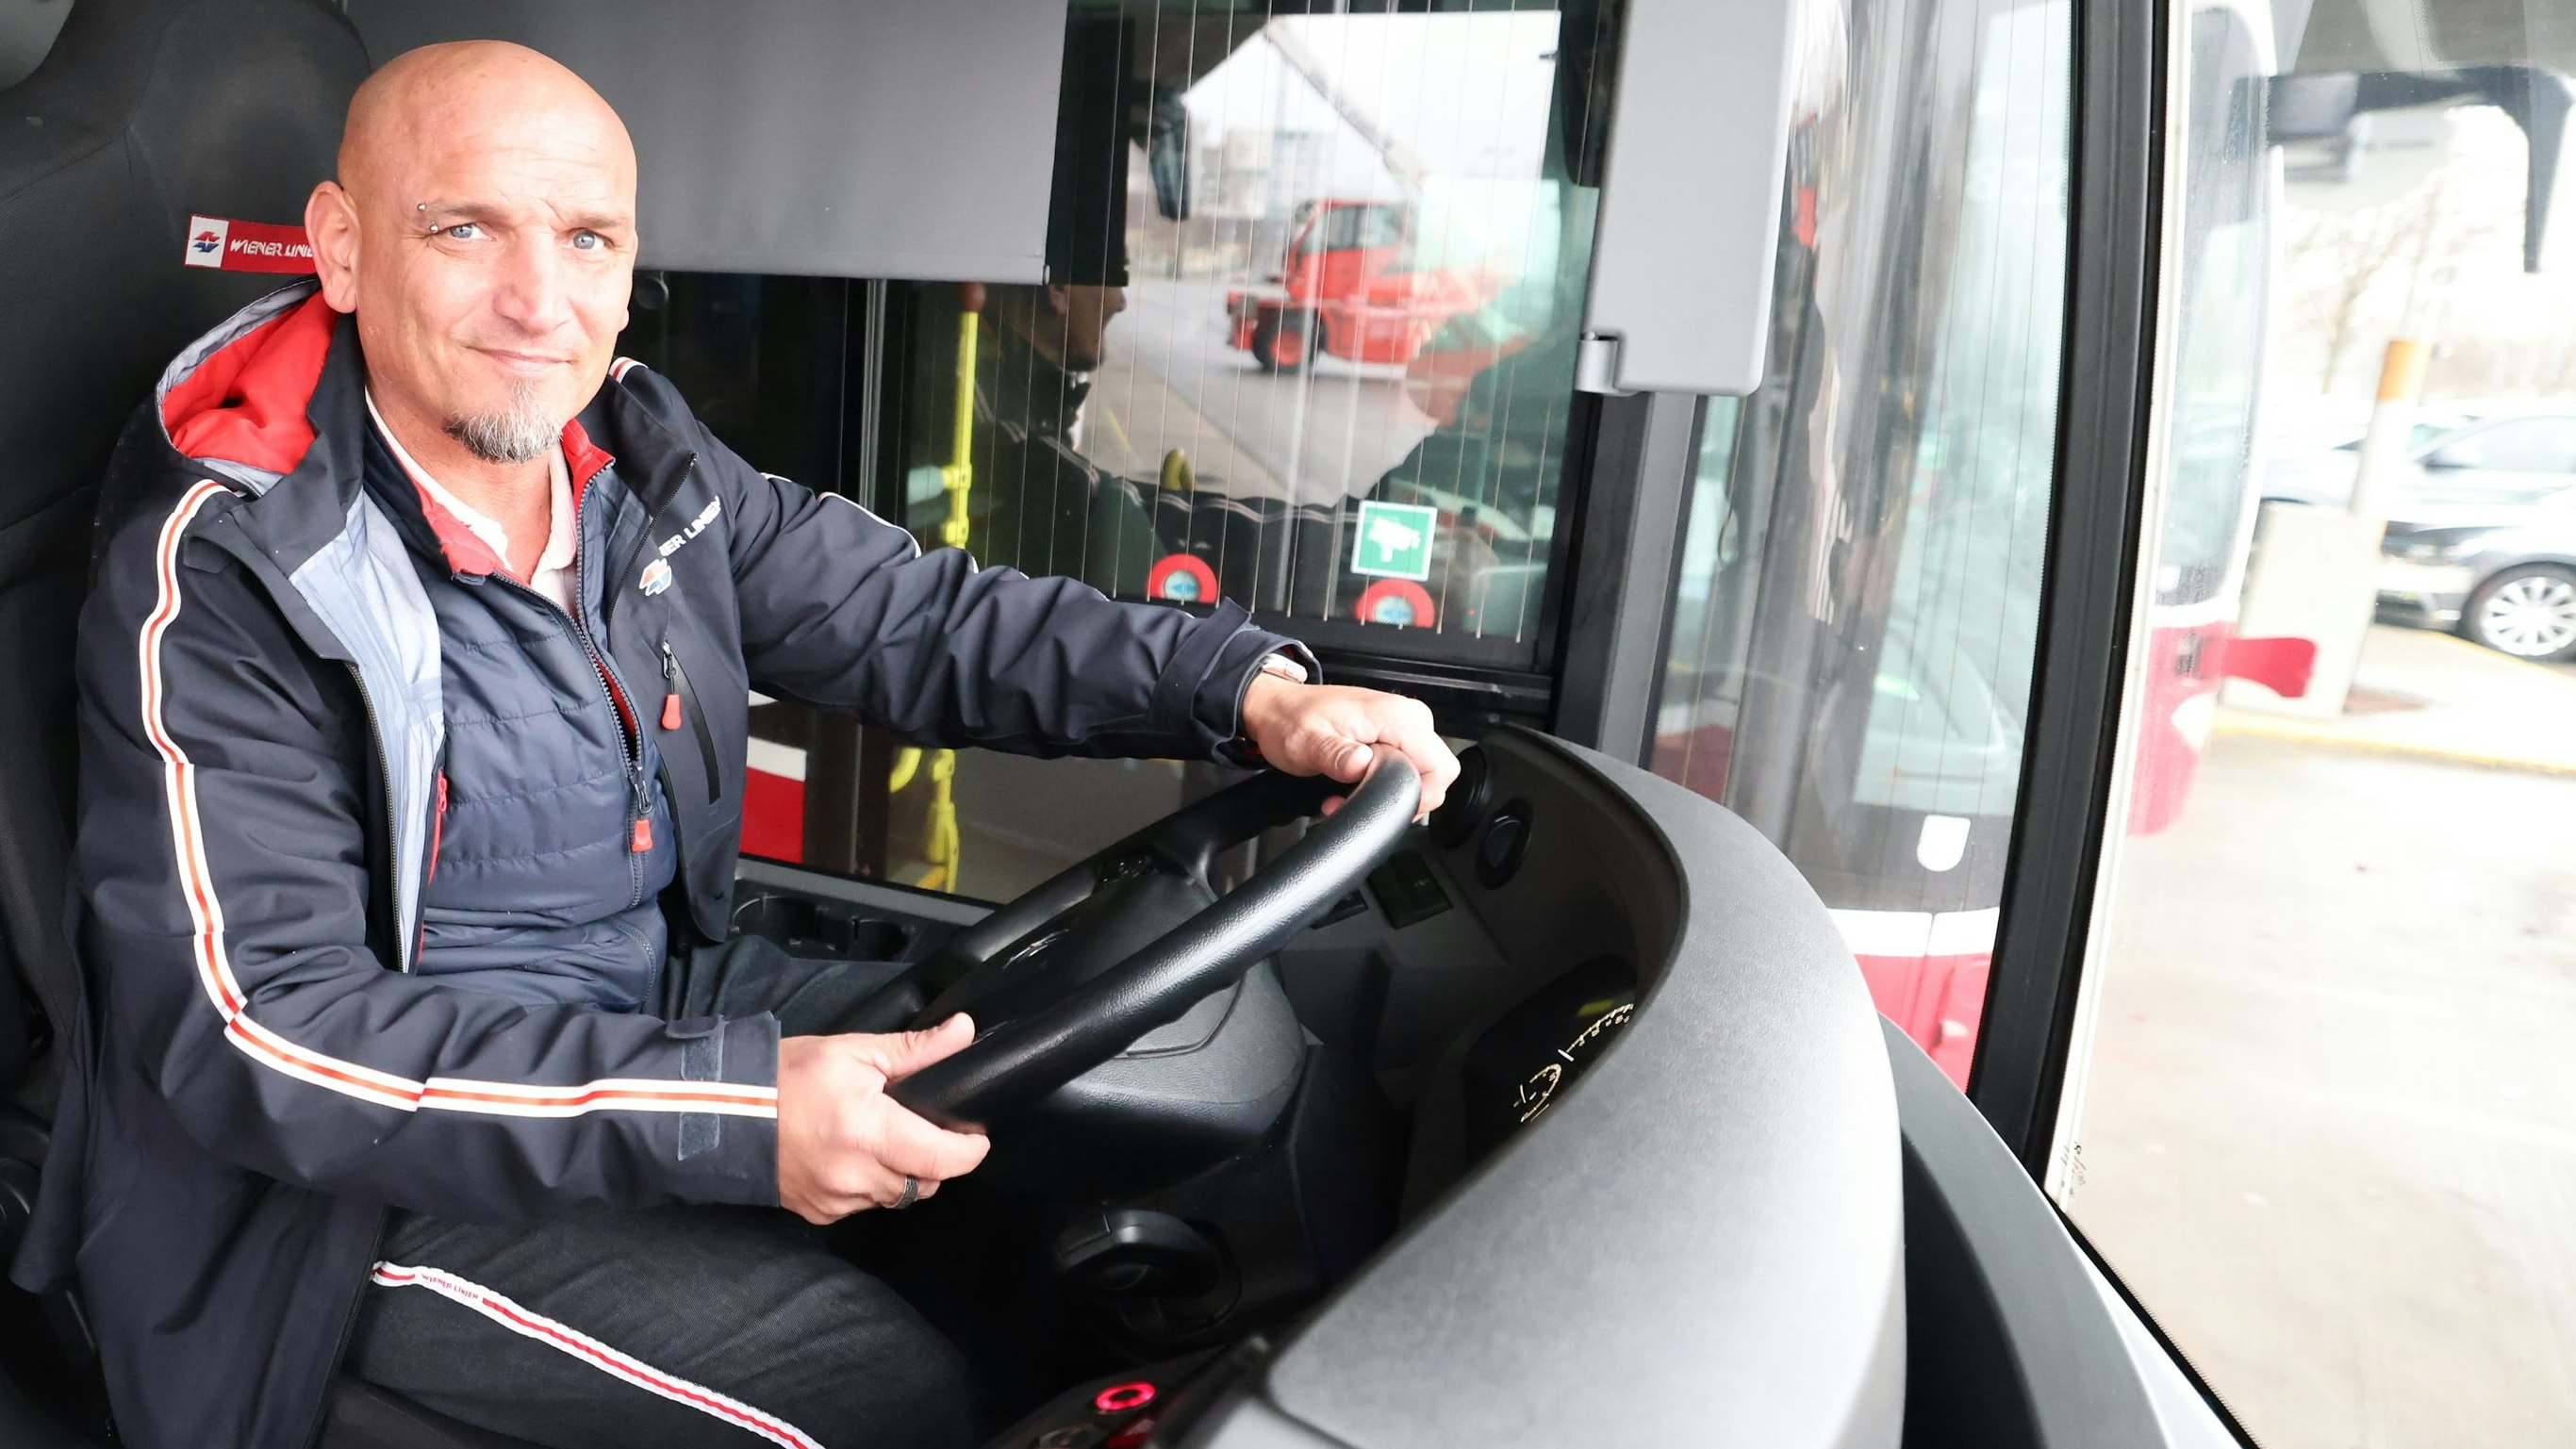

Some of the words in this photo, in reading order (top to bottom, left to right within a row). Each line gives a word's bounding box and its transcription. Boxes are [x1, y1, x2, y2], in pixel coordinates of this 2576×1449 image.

[230, 239, 283, 256] WIENER
[284, 243, 314, 258] LINIE
[421, 1273, 453, 1289] WIENER
[454, 1285, 479, 1299] LINIEN
